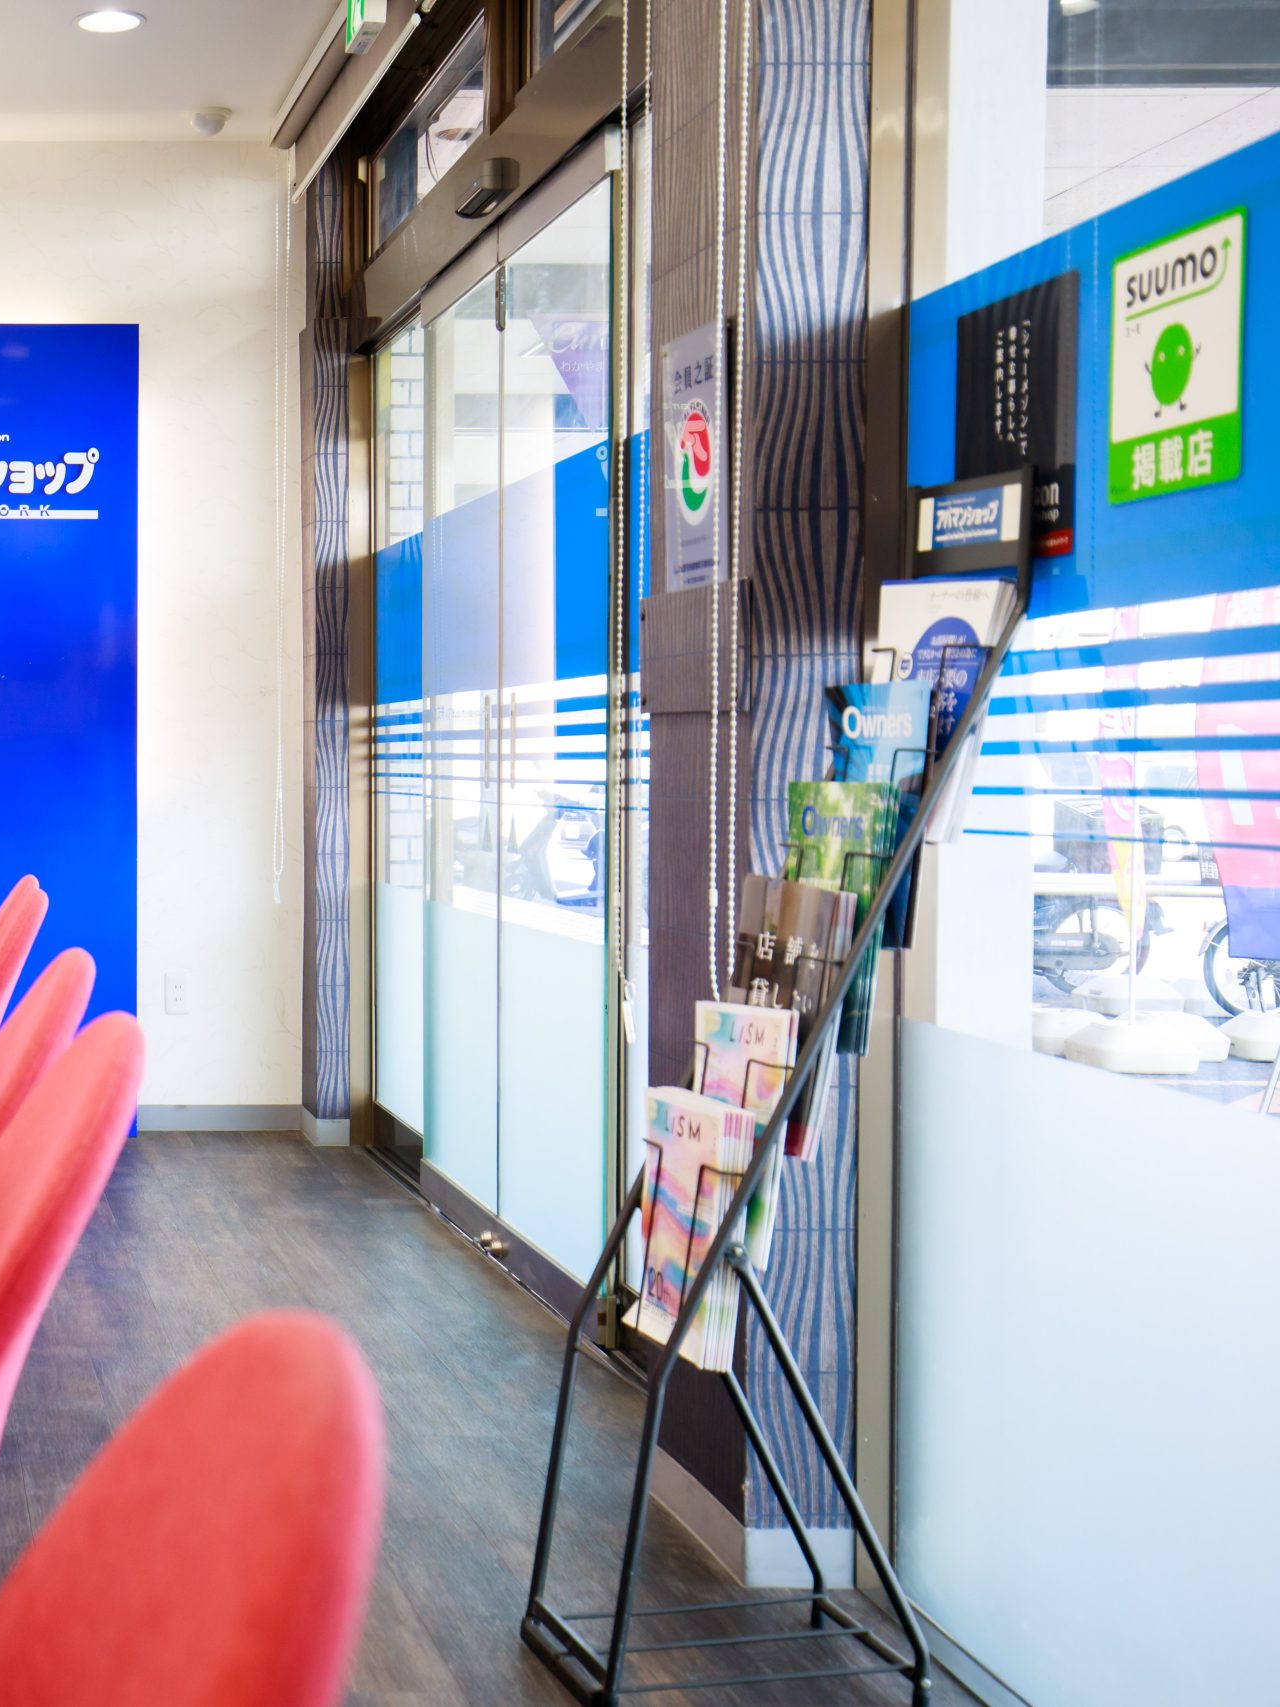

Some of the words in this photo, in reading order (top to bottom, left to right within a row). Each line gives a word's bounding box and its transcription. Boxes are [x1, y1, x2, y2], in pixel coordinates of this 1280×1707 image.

[673, 355, 715, 394] 会員之証
[1131, 427, 1214, 492] 掲載店
[936, 500, 1000, 530] アパマンショップ
[842, 705, 913, 739] Owners
[801, 805, 864, 838] Owners
